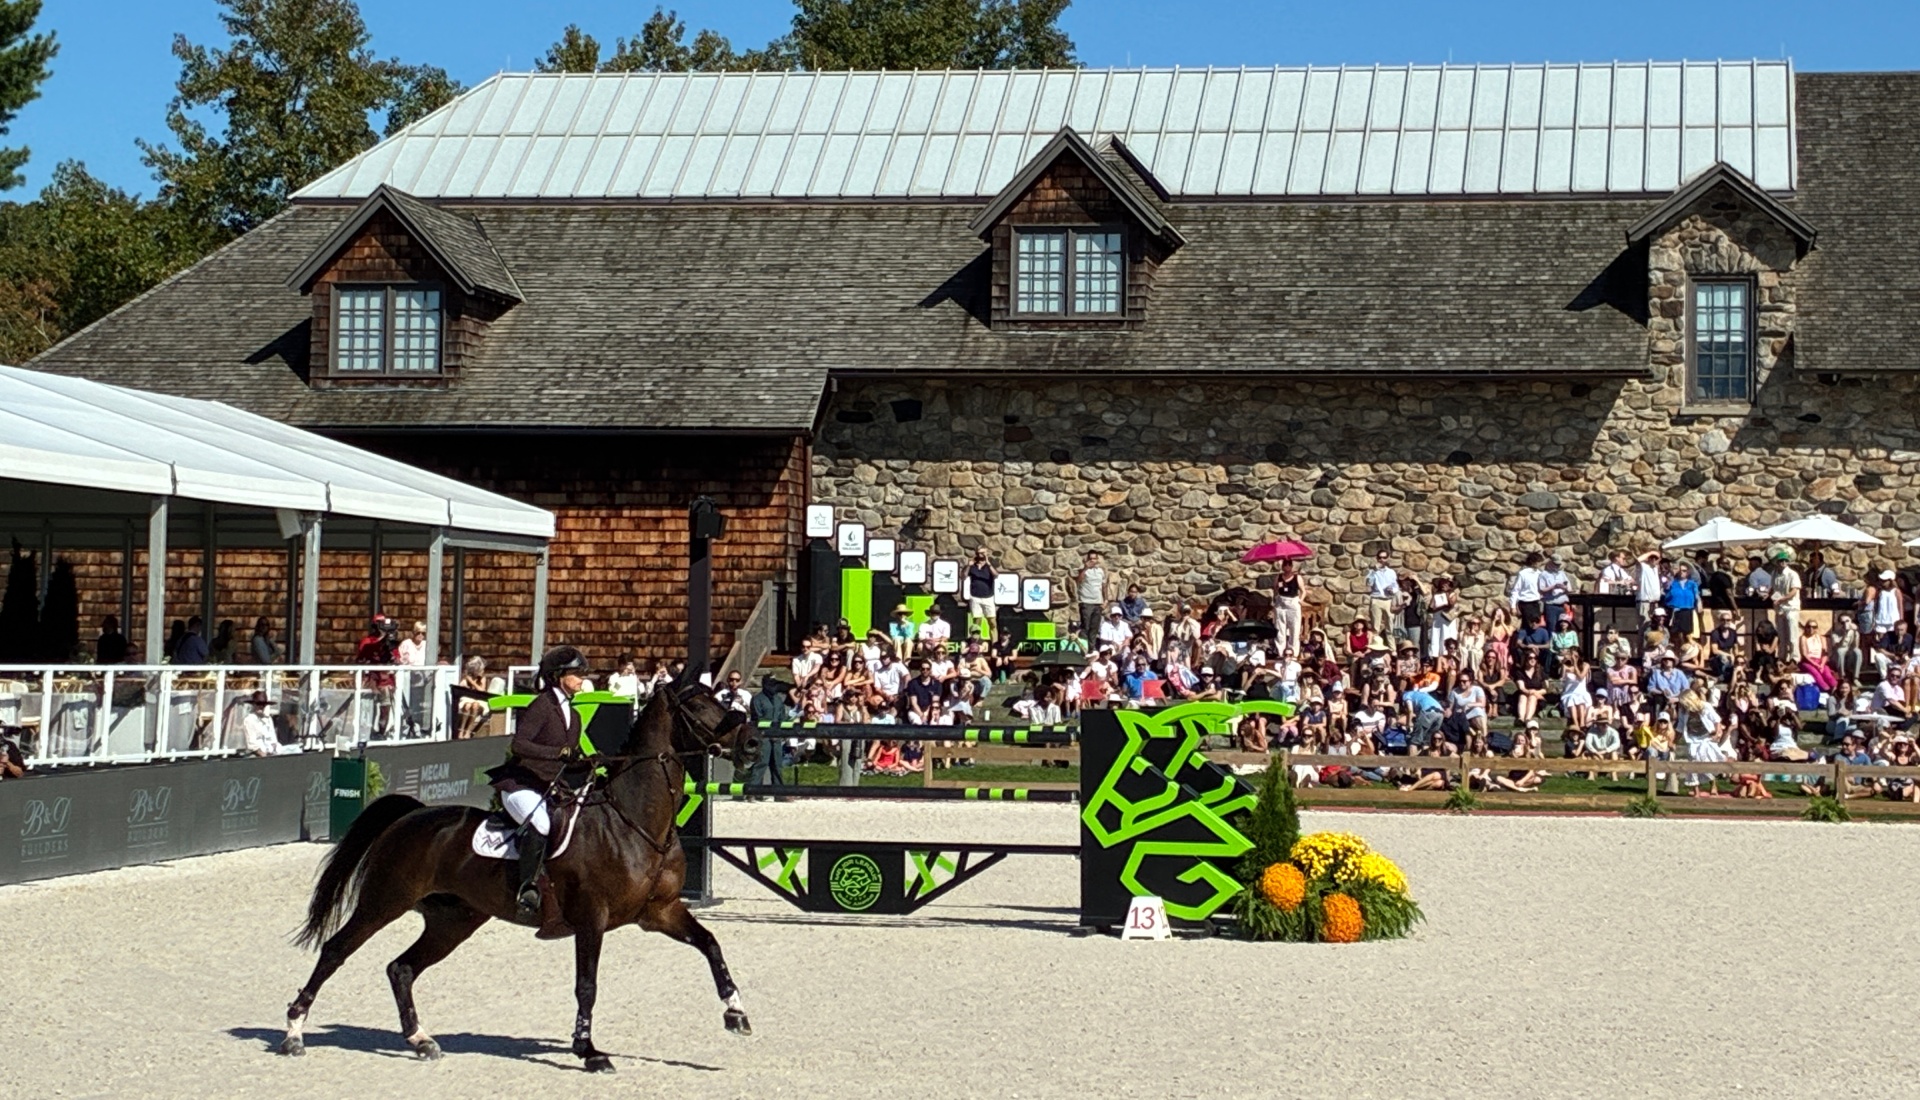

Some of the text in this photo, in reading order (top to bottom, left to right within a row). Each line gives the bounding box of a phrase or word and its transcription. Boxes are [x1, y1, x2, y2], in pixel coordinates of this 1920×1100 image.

[421, 762, 450, 781] MEGAN
[334, 788, 361, 798] FINISH
[420, 779, 469, 800] MCDERMOTT
[21, 839, 69, 857] BUILDERS
[1130, 906, 1155, 930] 13
